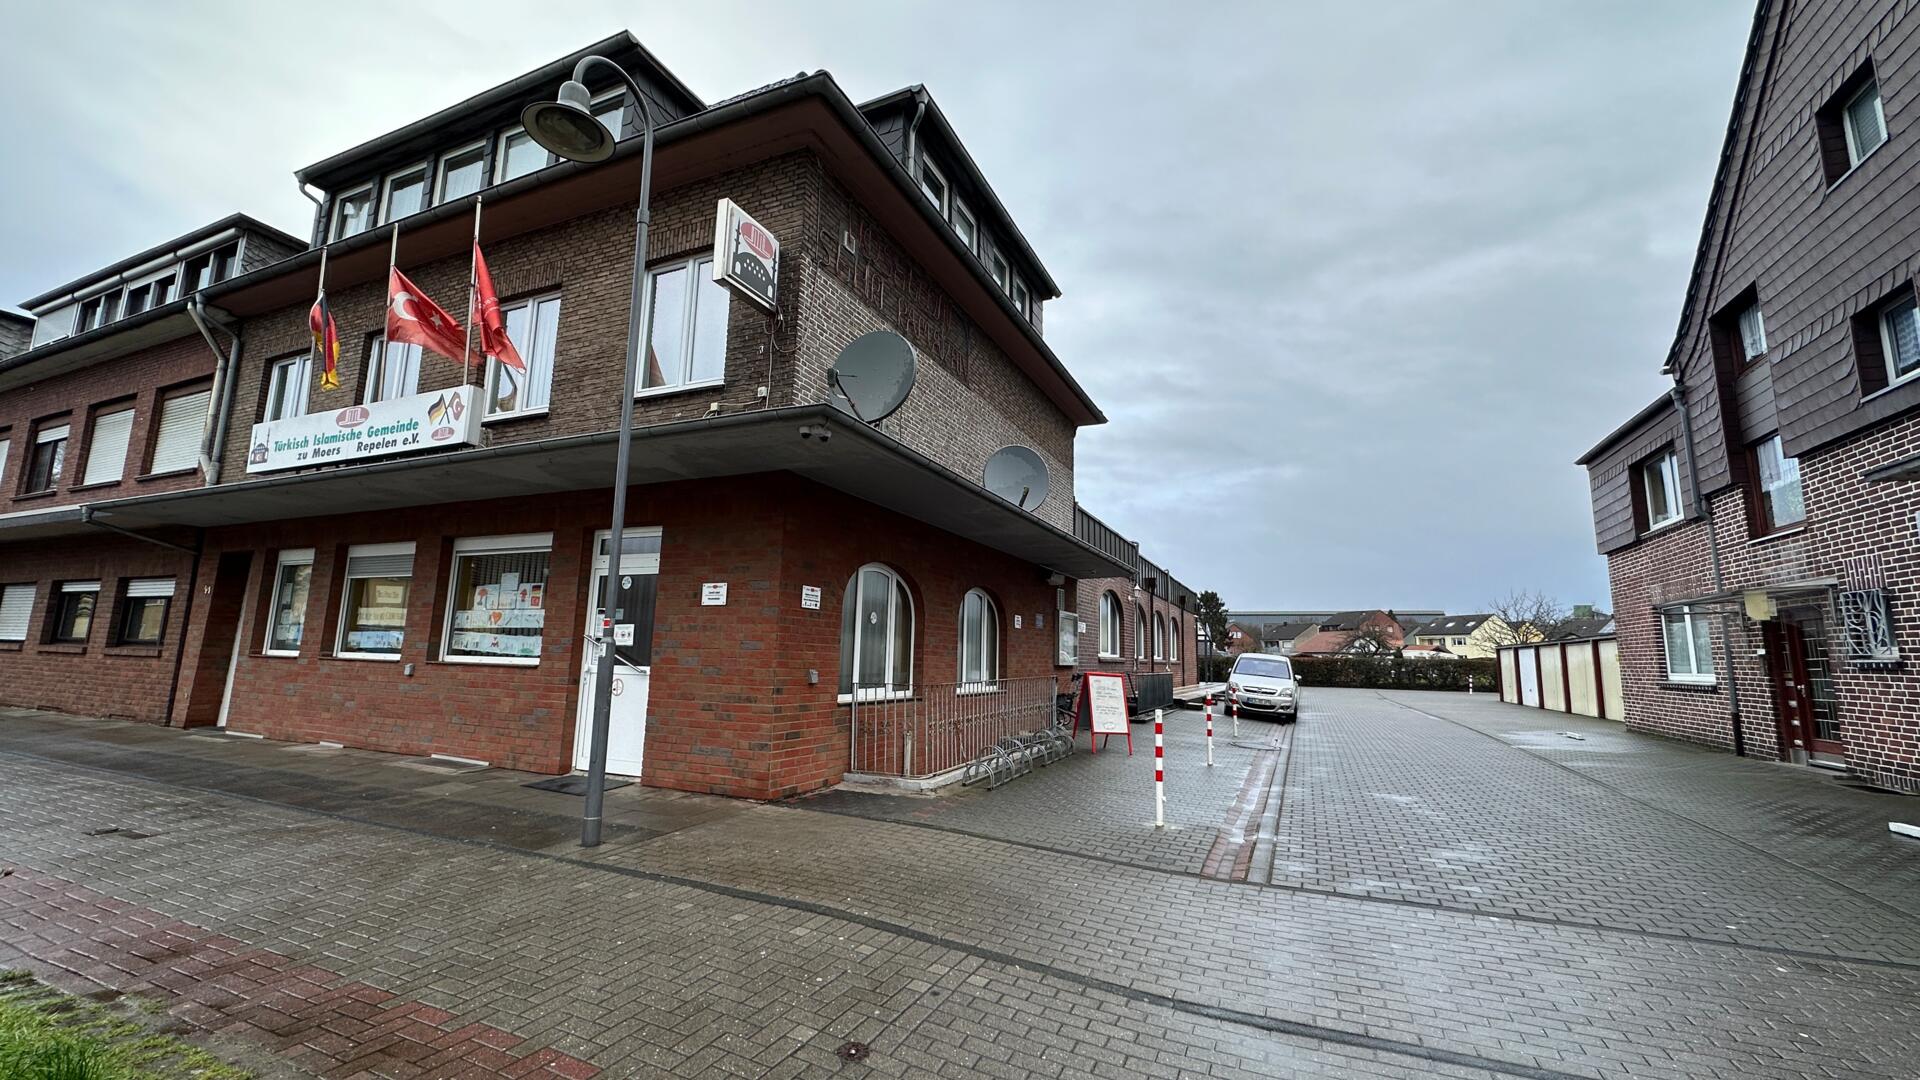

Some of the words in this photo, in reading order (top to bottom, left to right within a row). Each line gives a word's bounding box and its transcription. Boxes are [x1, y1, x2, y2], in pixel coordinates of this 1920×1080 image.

[274, 436, 309, 452] Türkisch
[313, 428, 362, 446] Islamische
[367, 418, 419, 437] Gemeinde
[297, 452, 308, 460] zu
[312, 447, 341, 458] Moers
[357, 437, 397, 453] Repelen
[402, 433, 420, 446] e.V.
